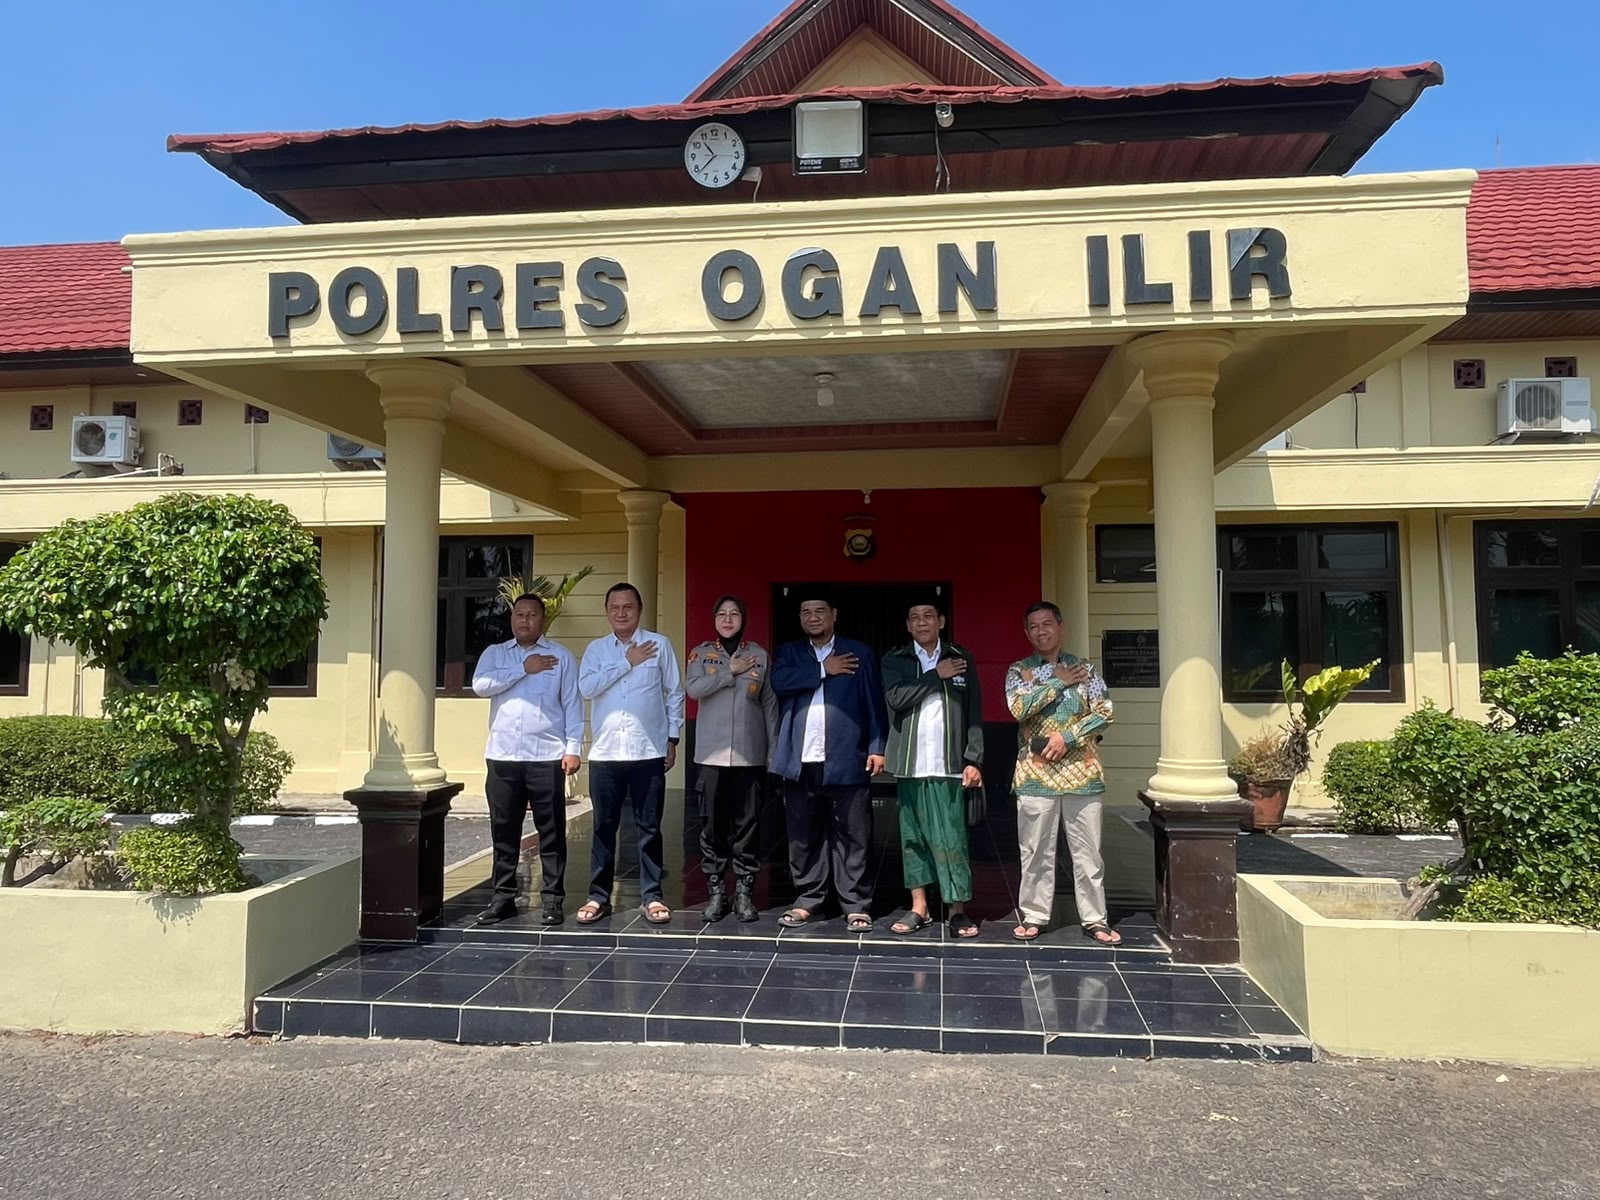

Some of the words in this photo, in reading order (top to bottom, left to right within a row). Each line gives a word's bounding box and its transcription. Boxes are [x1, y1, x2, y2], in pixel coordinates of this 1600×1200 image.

[700, 132, 708, 140] 11
[710, 128, 719, 137] 12
[692, 141, 701, 149] 10
[731, 139, 737, 147] 2
[690, 152, 696, 161] 9
[734, 150, 740, 159] 3
[693, 164, 699, 173] 8
[731, 162, 737, 171] 4
[703, 173, 709, 181] 7
[713, 175, 719, 183] 6
[724, 171, 730, 180] 5
[268, 256, 628, 338] POLRES
[701, 241, 998, 321] OGAN
[1086, 227, 1292, 307] ILIR
